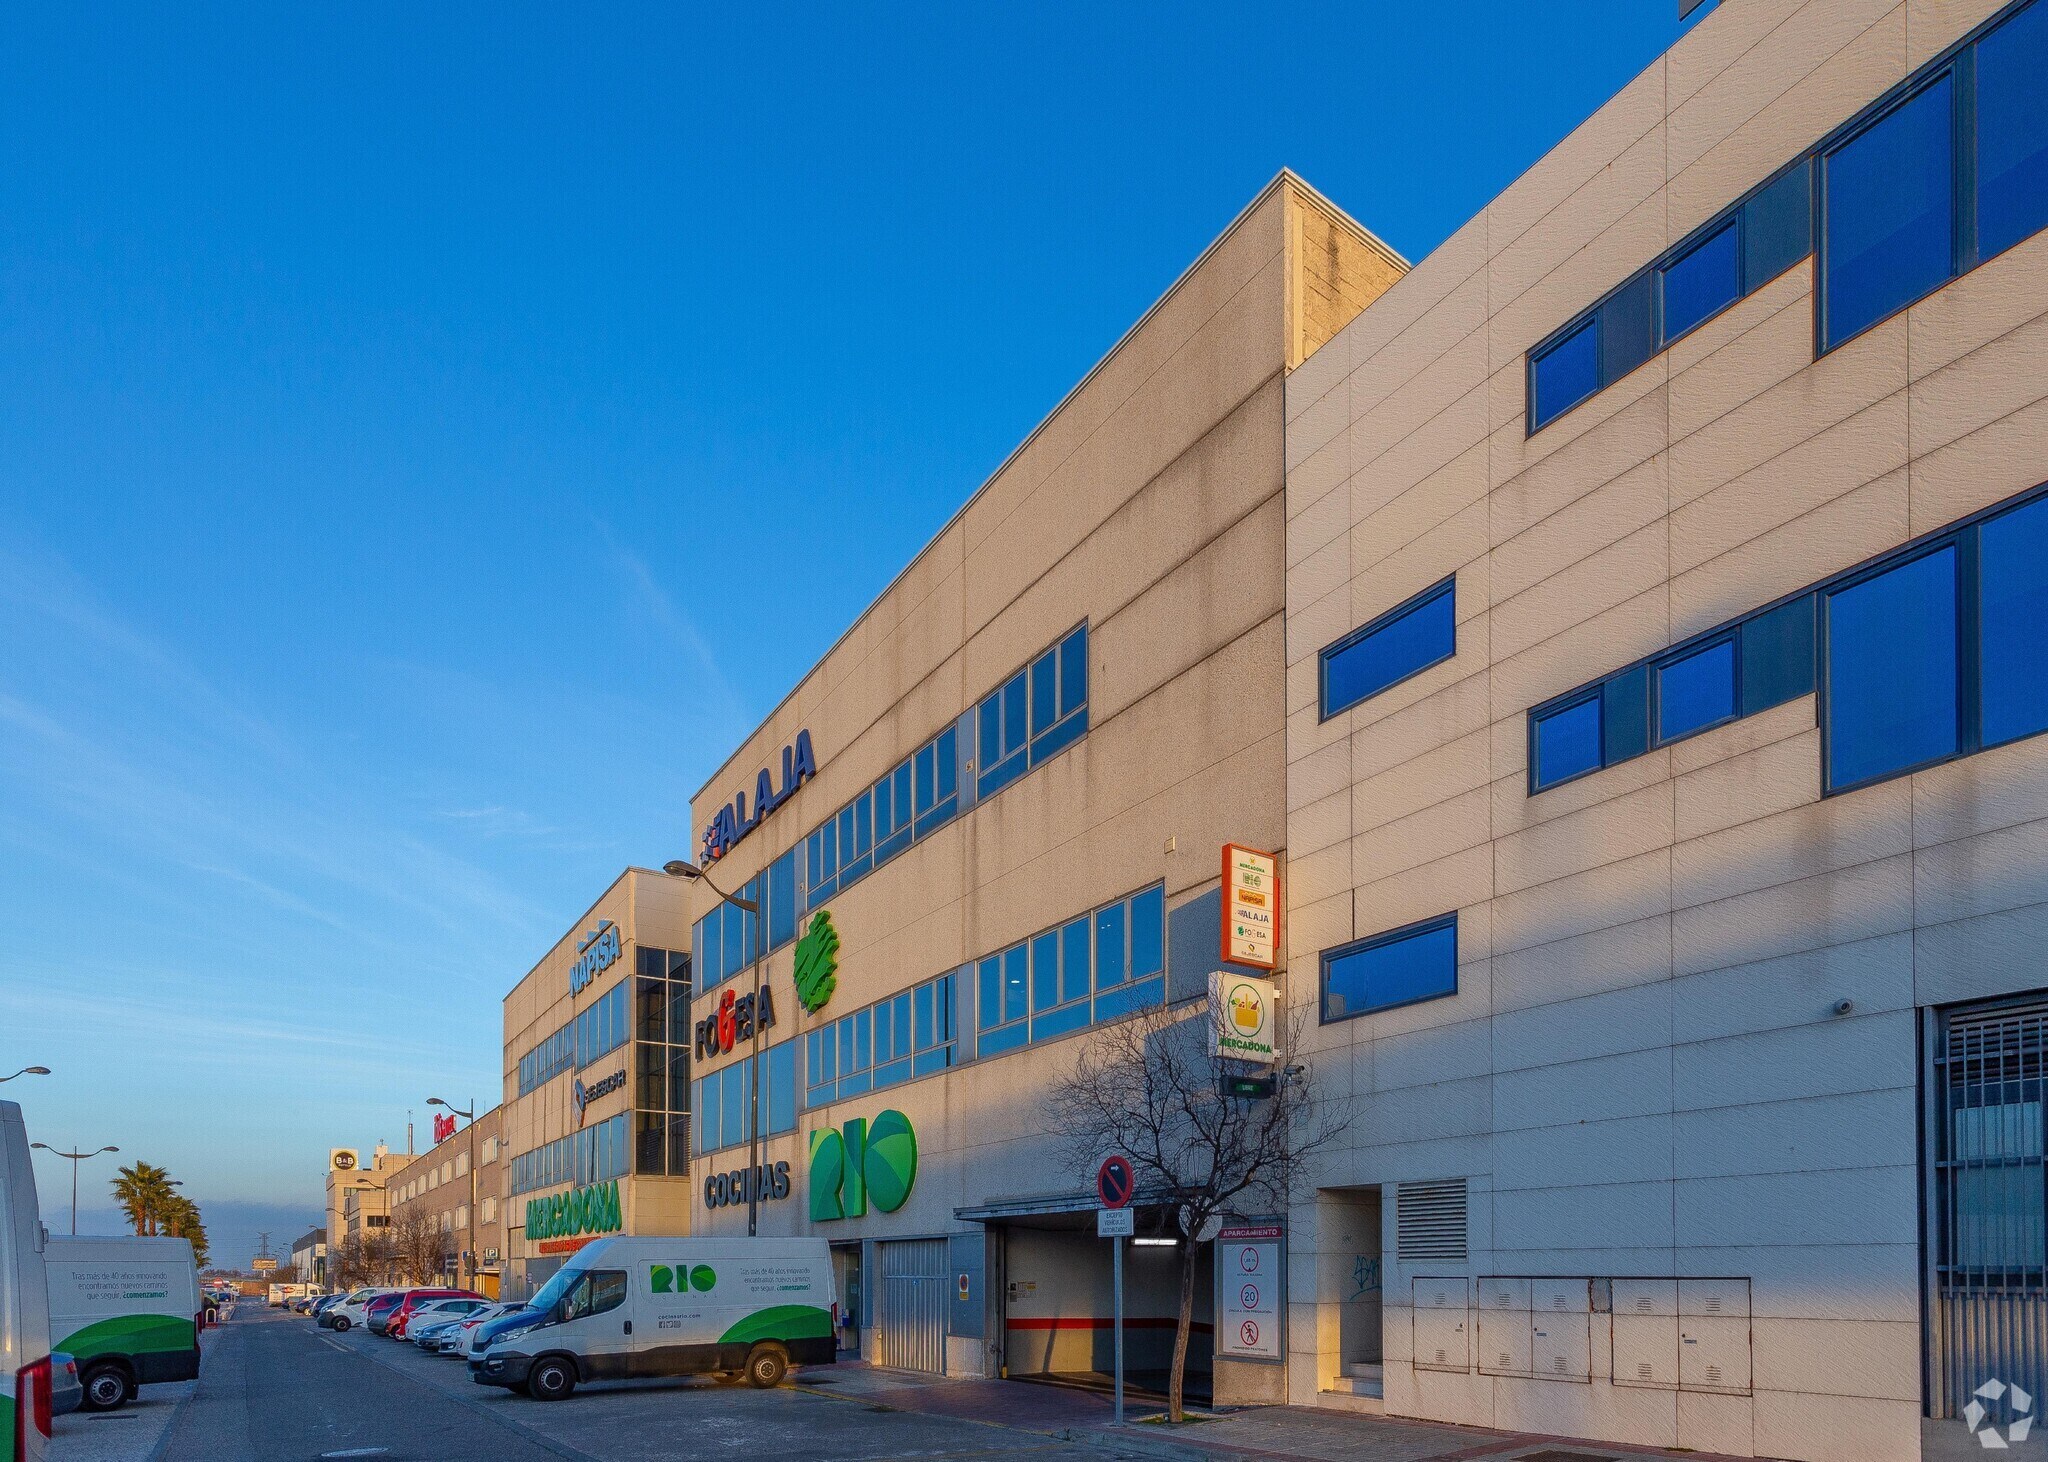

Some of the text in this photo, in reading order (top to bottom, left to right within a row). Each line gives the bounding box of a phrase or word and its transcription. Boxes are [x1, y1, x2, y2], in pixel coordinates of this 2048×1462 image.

[718, 728, 817, 856] ALAJA
[1239, 863, 1265, 873] MERCADONA
[1243, 910, 1270, 923] ALAJA
[1244, 928, 1266, 939] FOGESA
[569, 925, 622, 1000] NAPISA
[695, 985, 777, 1064] FOGESA
[1219, 1037, 1273, 1054] MERCADONA
[809, 1109, 919, 1223] RIO
[525, 1180, 623, 1241] MERCADONA
[1223, 1228, 1278, 1237] APARCAMIENTO
[489, 1249, 496, 1257] P
[72, 1271, 168, 1280] Tras más de 40 años innovando
[761, 1267, 768, 1275] de
[650, 1264, 717, 1293] RIO
[78, 1281, 168, 1290] encontramos nuevos caminos
[86, 1292, 100, 1301] que
[122, 1290, 168, 1299] ¿comenzamos?
[1244, 1291, 1256, 1302] 20
